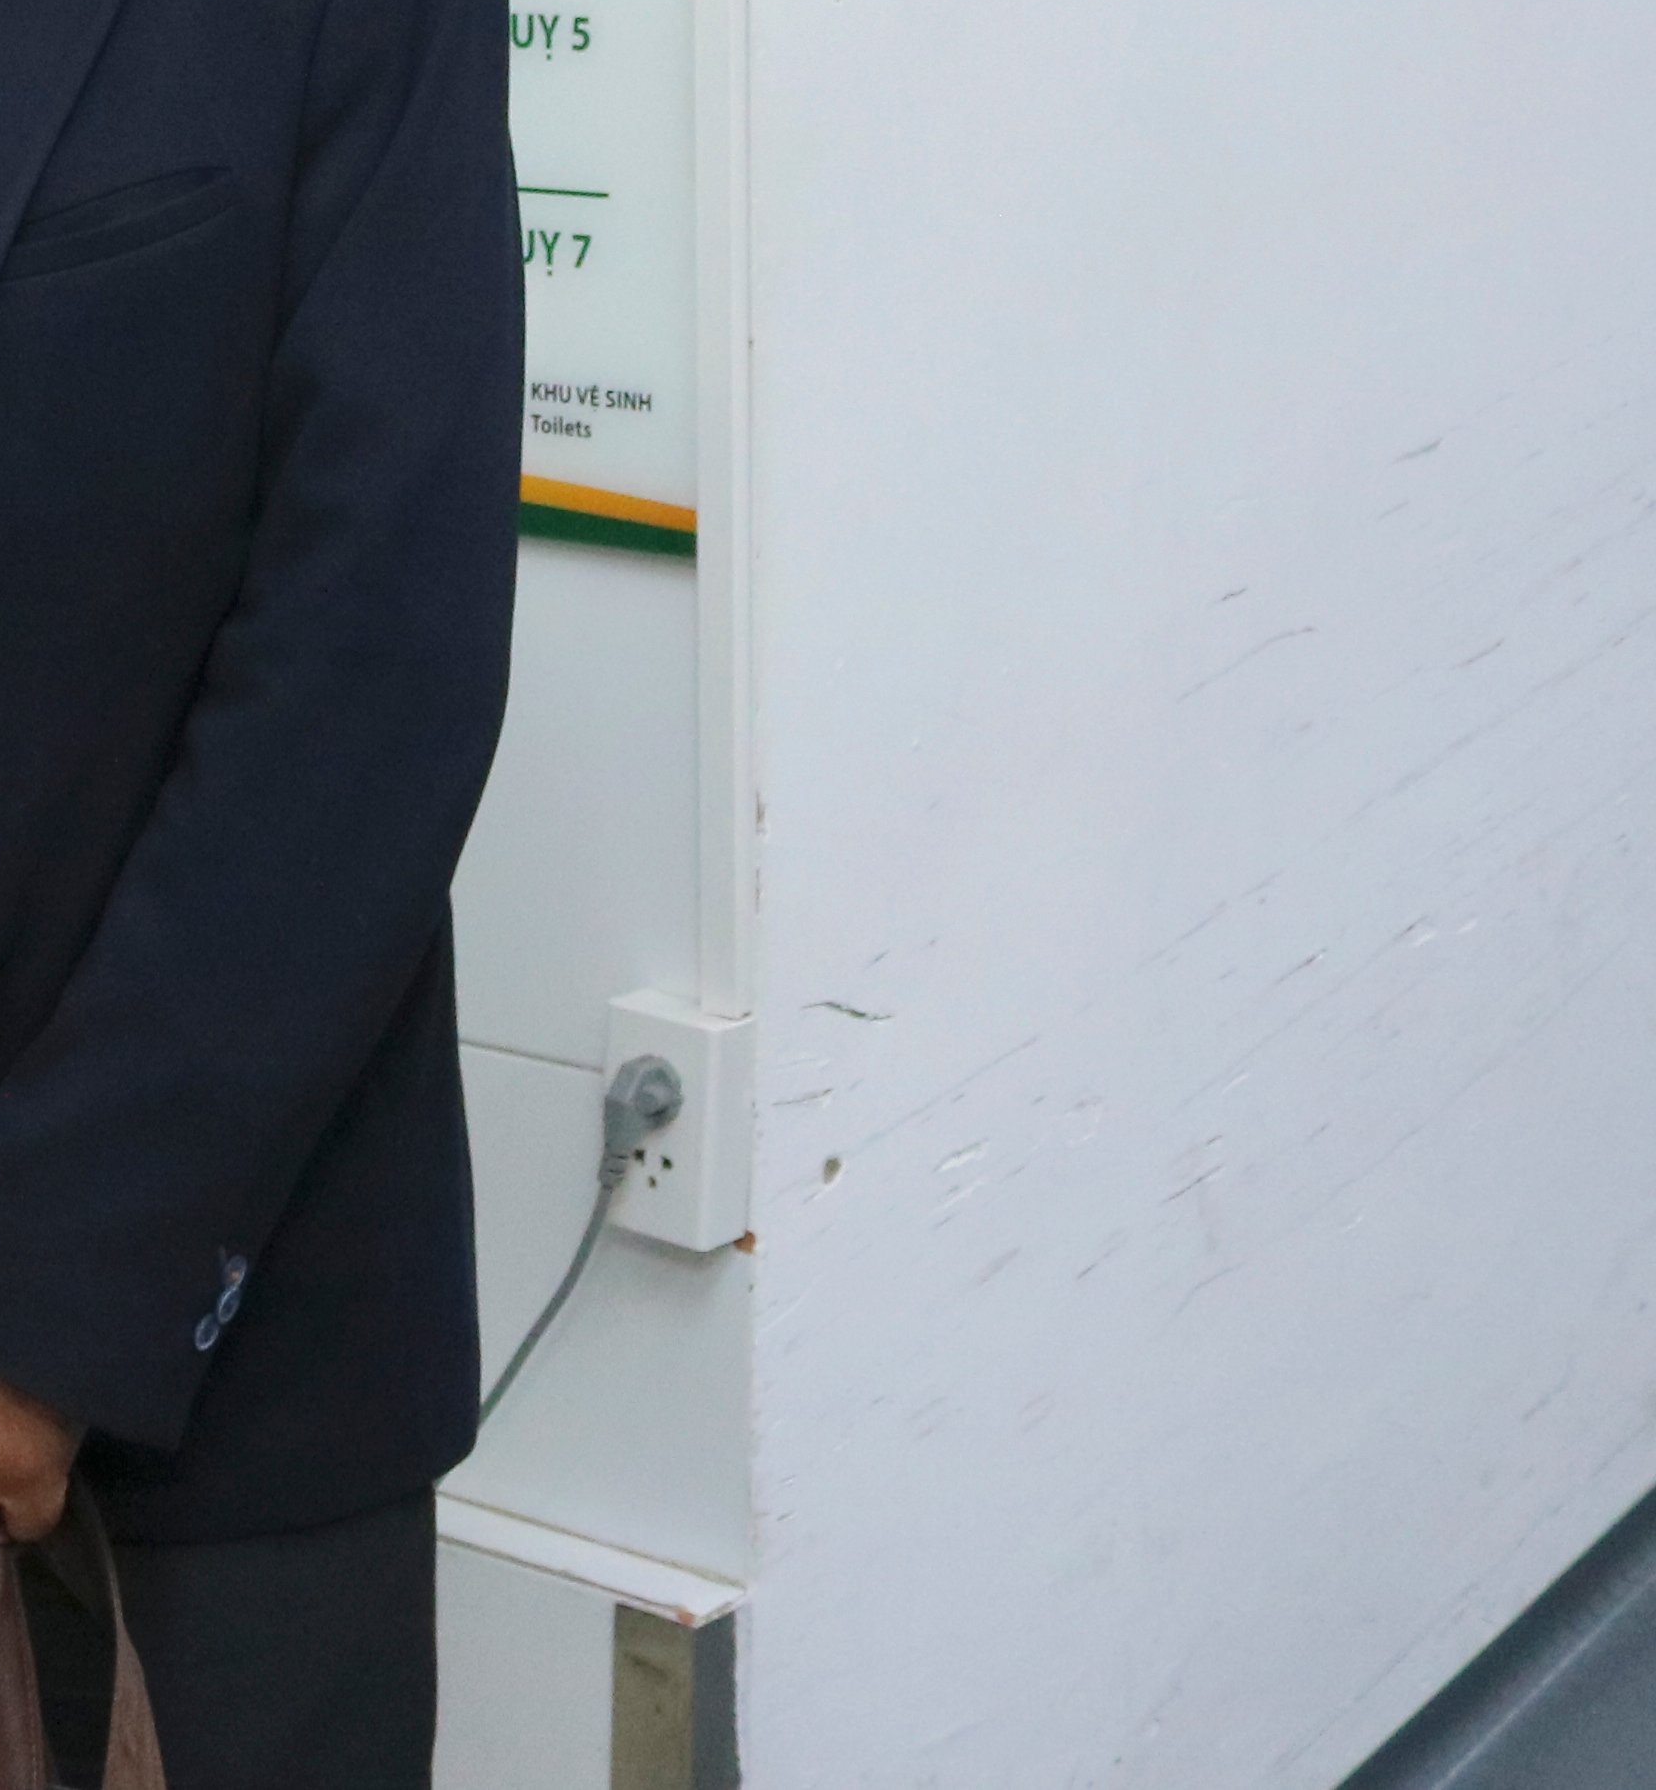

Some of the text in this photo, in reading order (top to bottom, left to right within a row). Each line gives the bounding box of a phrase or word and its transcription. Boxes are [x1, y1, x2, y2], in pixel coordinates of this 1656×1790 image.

[510, 12, 590, 60] UỴ 5
[572, 234, 592, 268] 7
[532, 383, 571, 403] KHU
[606, 390, 651, 411] SINH
[531, 414, 591, 438] Toilets
